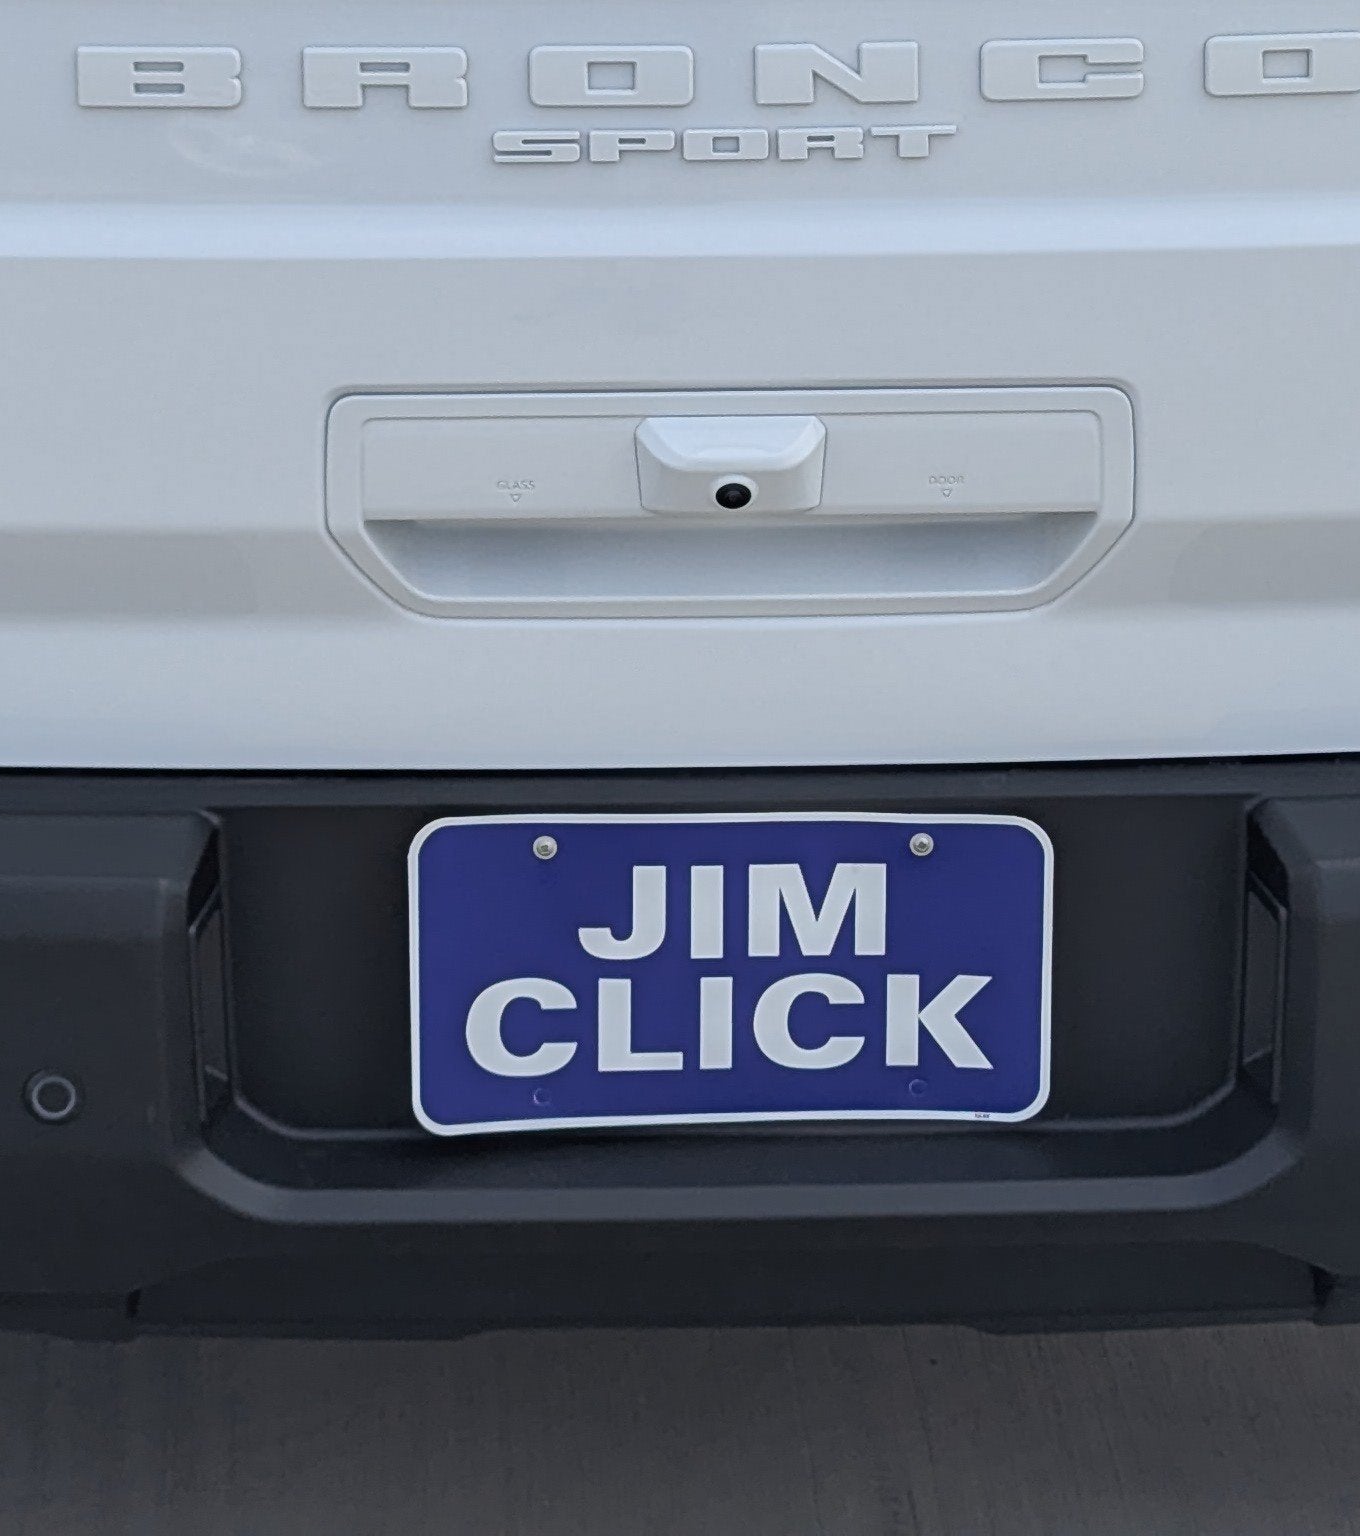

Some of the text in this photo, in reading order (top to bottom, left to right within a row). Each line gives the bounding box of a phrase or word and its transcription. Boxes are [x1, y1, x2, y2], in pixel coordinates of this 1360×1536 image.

[492, 125, 957, 164] SPORT
[578, 863, 886, 960] JIM
[465, 973, 994, 1078] CLICK
